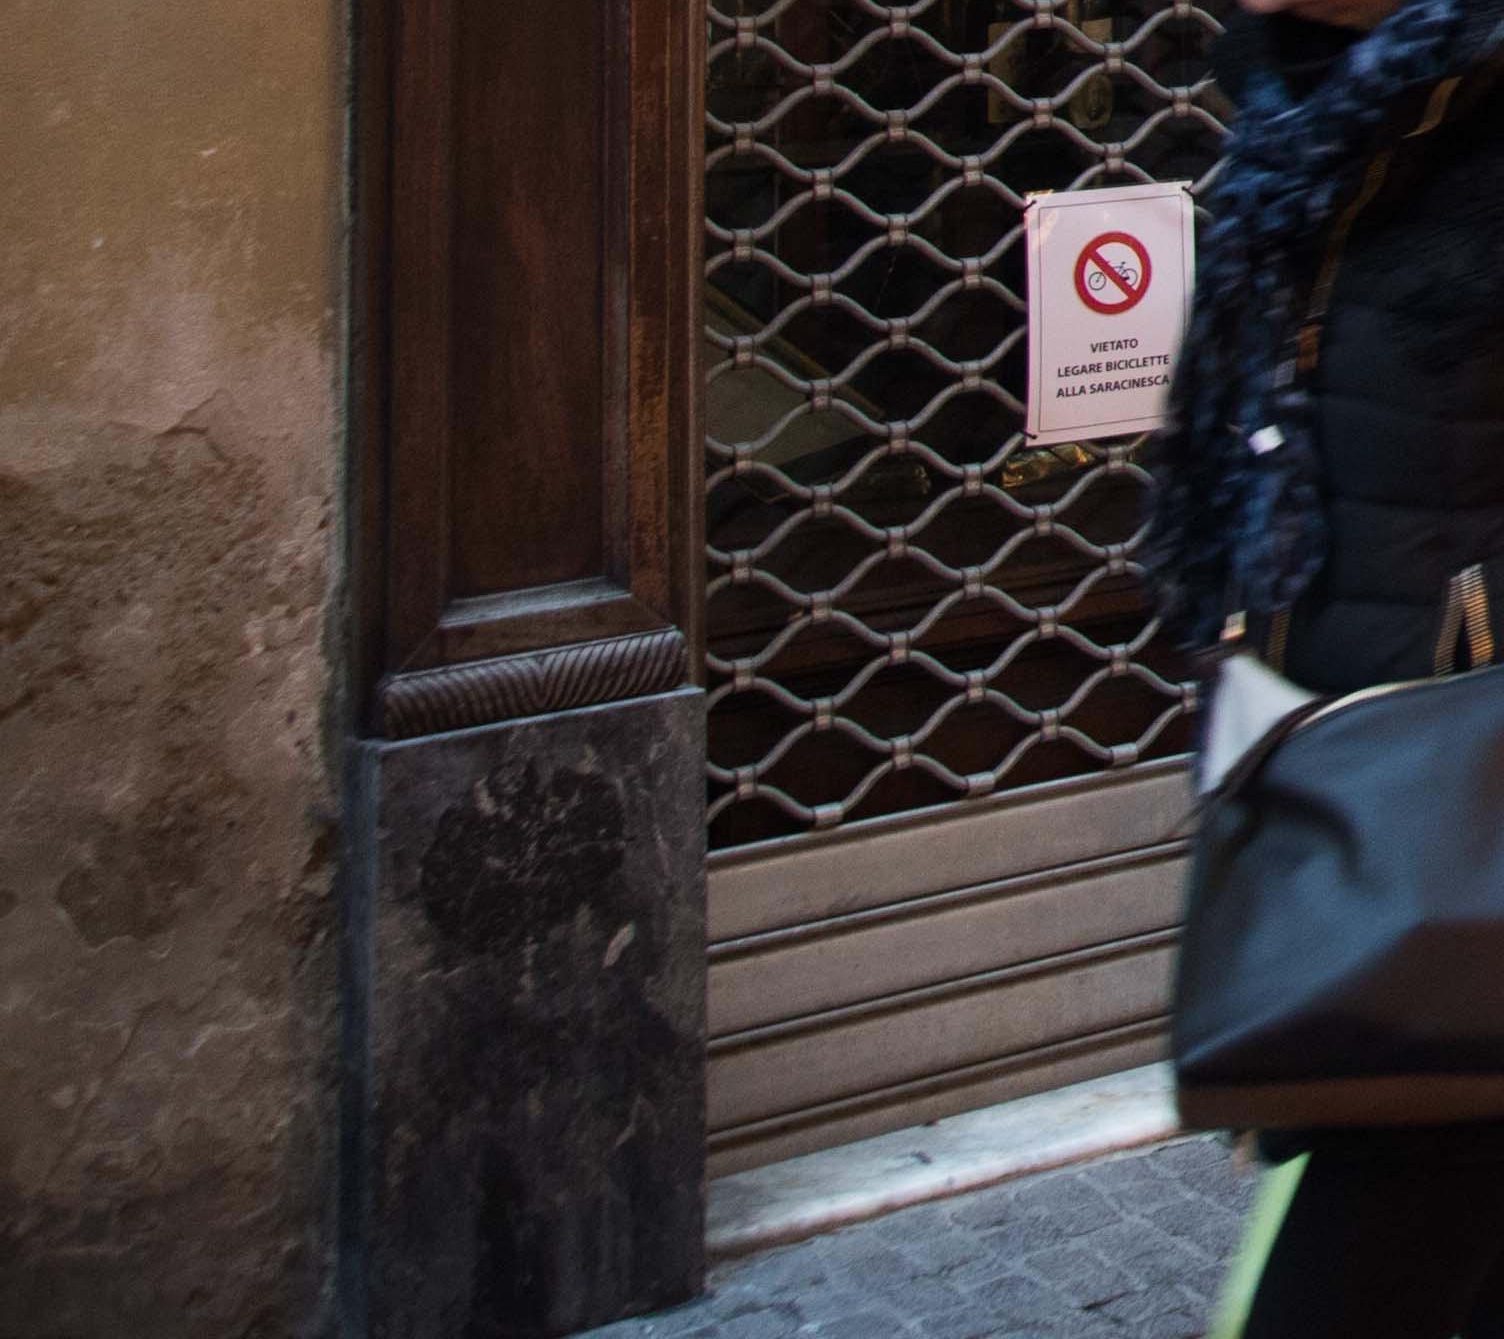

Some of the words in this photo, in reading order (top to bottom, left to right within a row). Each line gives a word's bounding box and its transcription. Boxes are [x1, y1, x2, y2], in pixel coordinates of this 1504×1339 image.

[1090, 337, 1139, 354] VIETATO
[1057, 361, 1102, 378] LEGARE
[1105, 354, 1170, 372] BICICLETTE
[1056, 384, 1086, 399] ALLA
[1089, 374, 1170, 394] SARACINESCA
